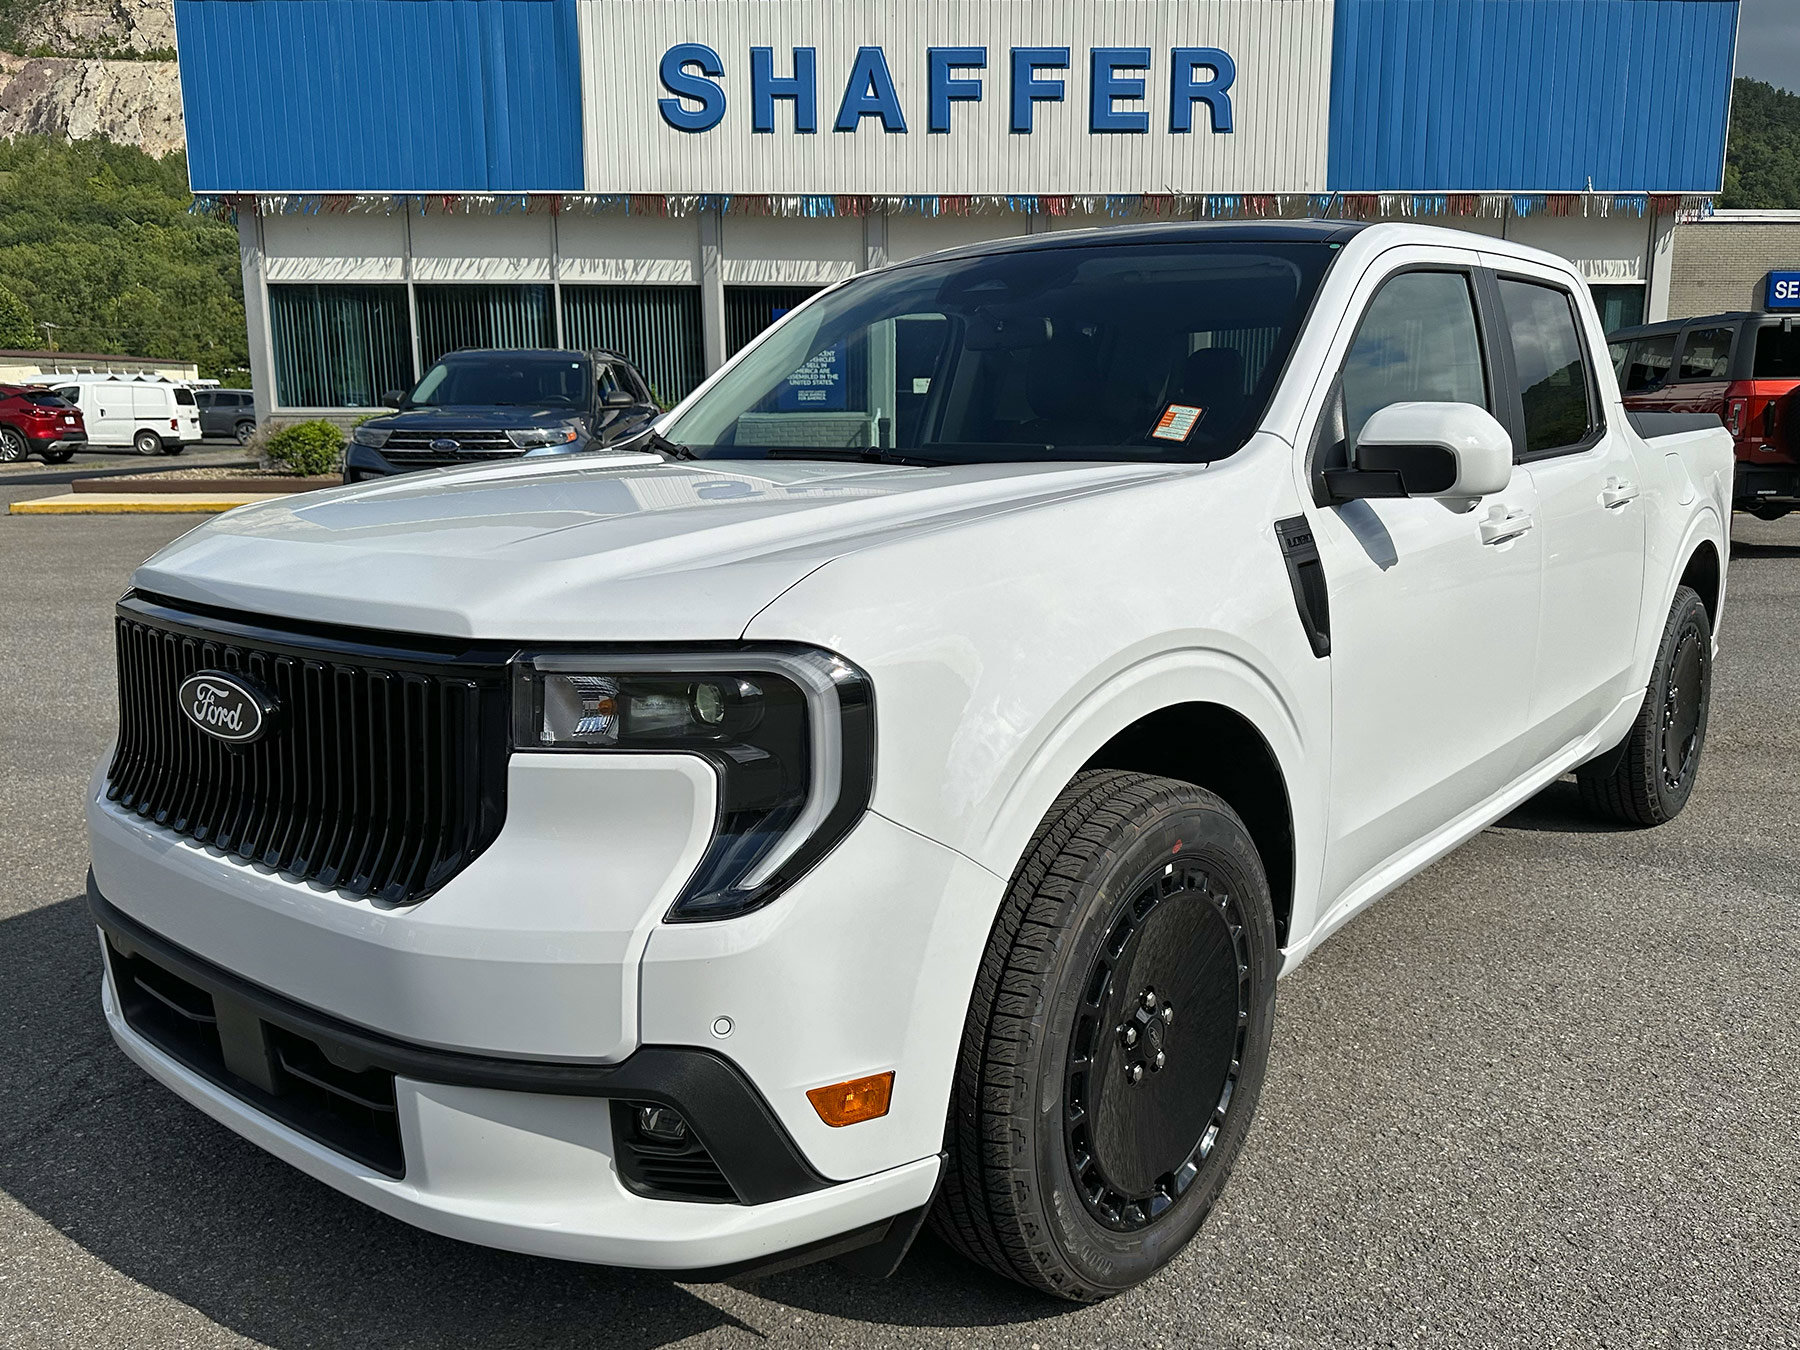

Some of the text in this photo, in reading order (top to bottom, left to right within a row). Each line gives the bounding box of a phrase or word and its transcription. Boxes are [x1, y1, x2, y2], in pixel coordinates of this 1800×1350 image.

[658, 42, 1236, 134] SHAFFER
[1775, 281, 1800, 299] SE
[193, 683, 243, 731] Ford
